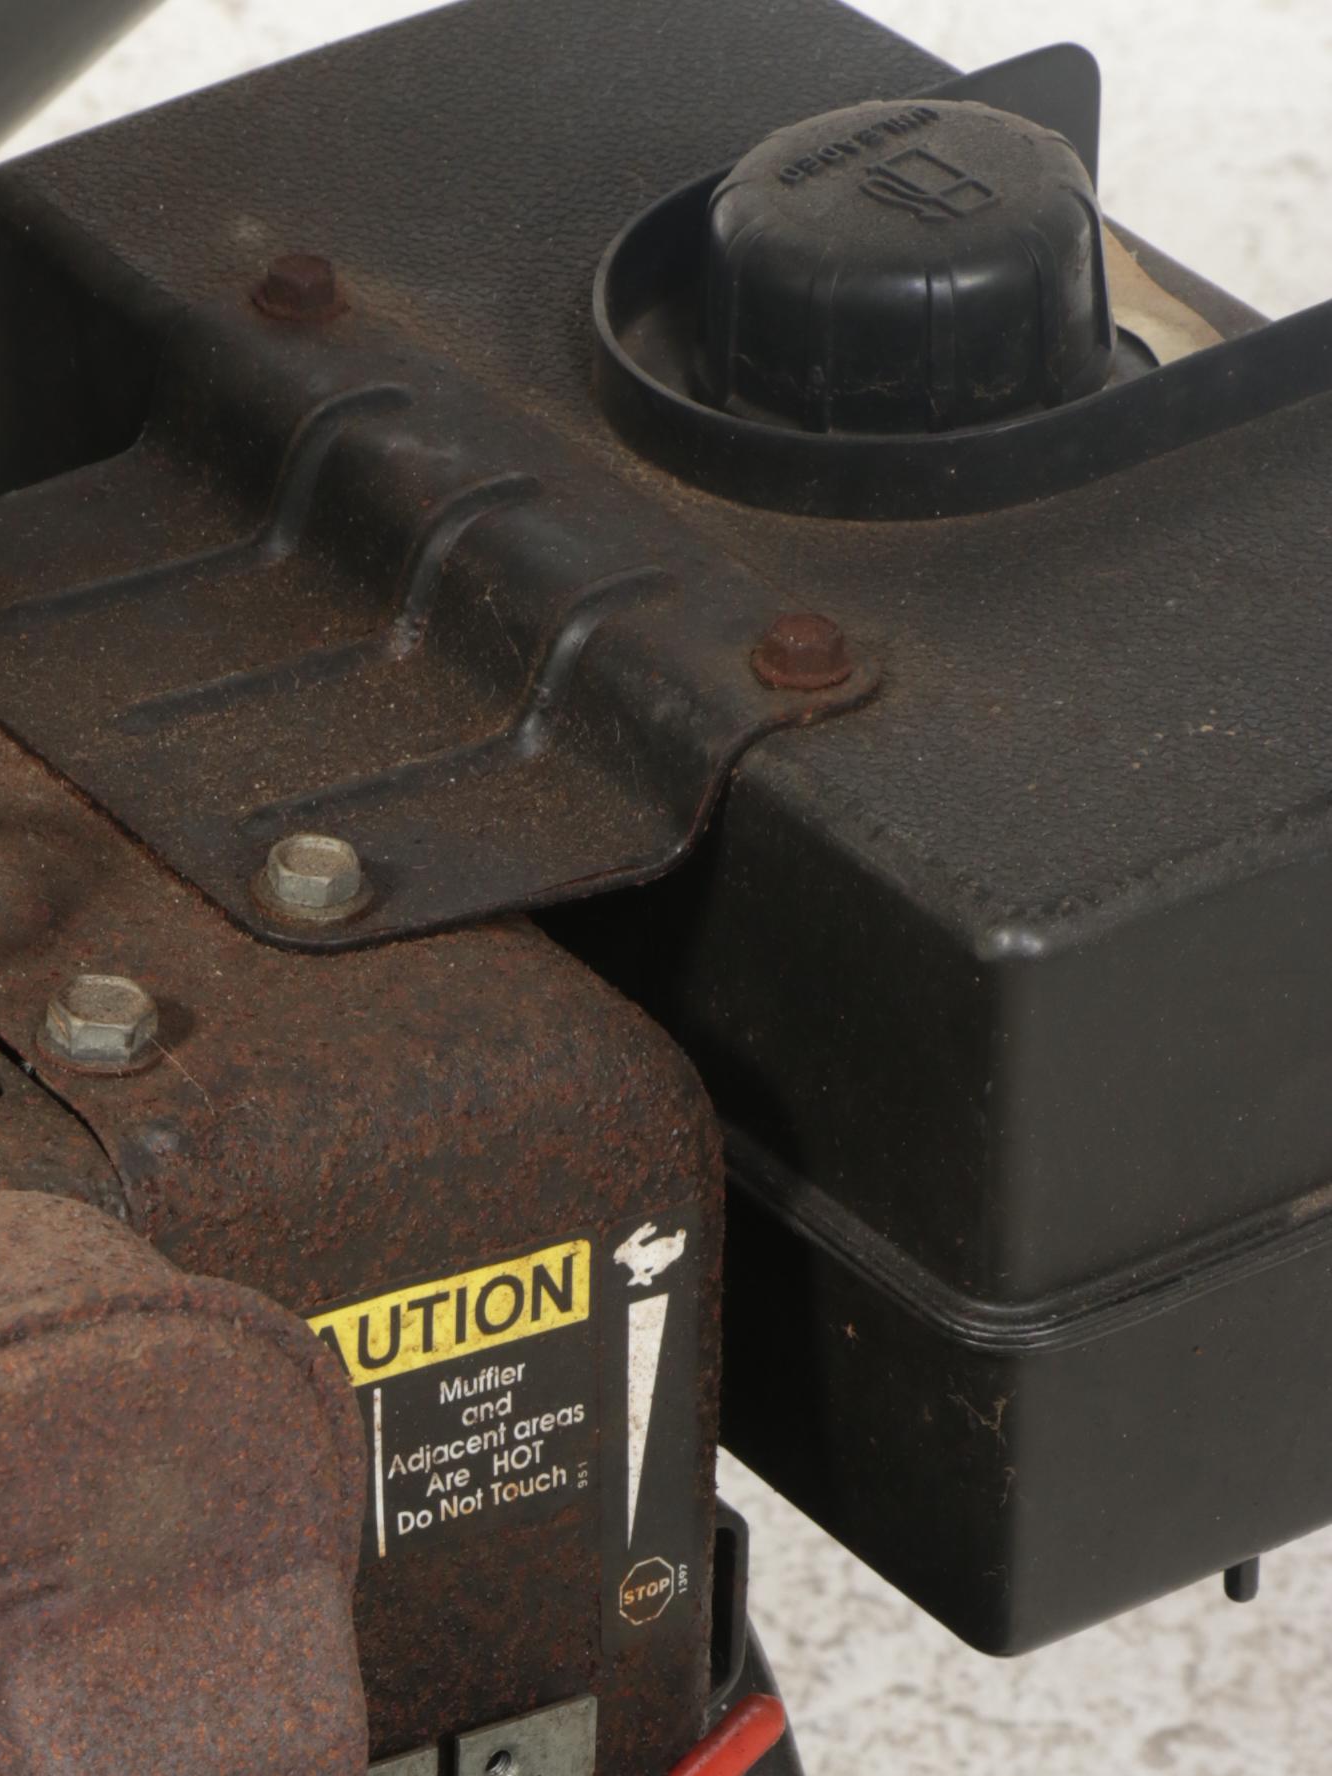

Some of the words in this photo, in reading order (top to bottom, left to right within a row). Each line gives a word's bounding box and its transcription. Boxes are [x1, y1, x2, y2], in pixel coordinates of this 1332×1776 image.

[439, 1362, 526, 1405] Muffler
[461, 1391, 513, 1427] and
[387, 1426, 506, 1479] Adjacent
[513, 1403, 585, 1442] areas
[425, 1468, 470, 1497] Are
[492, 1441, 545, 1477] HOT
[577, 1461, 588, 1489] 951
[397, 1511, 433, 1535] Do
[439, 1494, 483, 1522] Not
[490, 1466, 567, 1506] Touch
[623, 1577, 671, 1606] STOP
[678, 1563, 688, 1594] 1397
